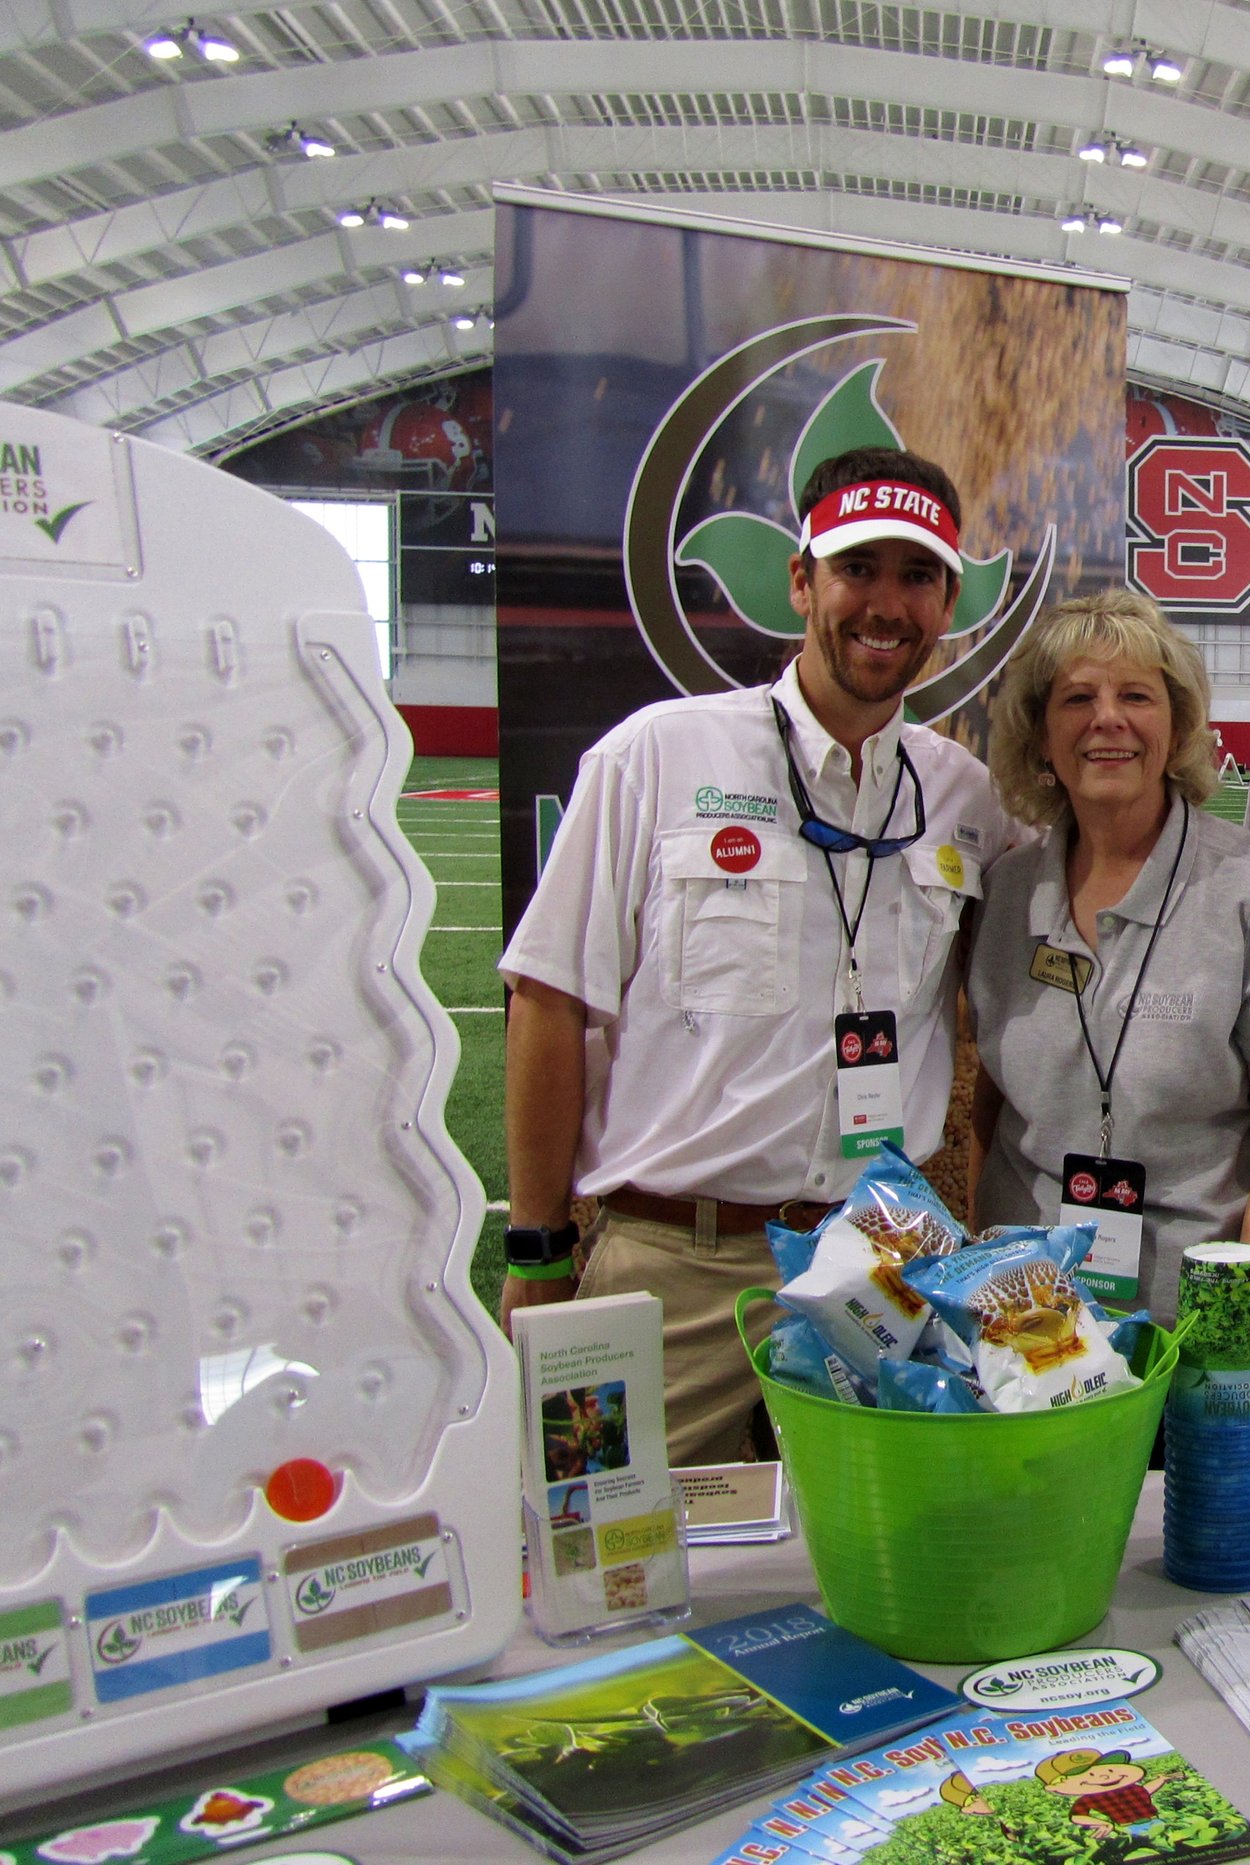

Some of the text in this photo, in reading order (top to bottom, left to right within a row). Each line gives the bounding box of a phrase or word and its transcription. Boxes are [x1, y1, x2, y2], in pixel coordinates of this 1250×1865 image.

[839, 486, 941, 526] NC STATE
[724, 801, 777, 816] SOYBEAN
[748, 795, 778, 804] CAROLINA
[716, 845, 755, 858] ALUMNI
[845, 1298, 869, 1319] HIGH
[872, 1325, 898, 1348] OLEIC
[540, 1342, 610, 1361] North Carolina
[540, 1350, 634, 1374] Soybean Producers
[541, 1369, 597, 1385] Association
[1050, 1389, 1072, 1408] HIGH
[1084, 1372, 1107, 1393] OLEIC
[324, 1546, 421, 1587] NC SOYBEANS
[130, 1614, 154, 1633] NC
[716, 1616, 817, 1651] 2018
[734, 1626, 827, 1658] Annual Report
[1007, 1656, 1117, 1682] NC SOYBEAN
[1027, 1667, 1124, 1687] PRODUCERS
[1031, 1673, 1127, 1691] ASSOCIATION
[1040, 1687, 1110, 1703] ncsoy.org
[943, 1706, 1137, 1751] N.C. Soybeans
[1048, 1723, 1146, 1747] Leading the Field
[830, 1759, 896, 1788] N.C.
